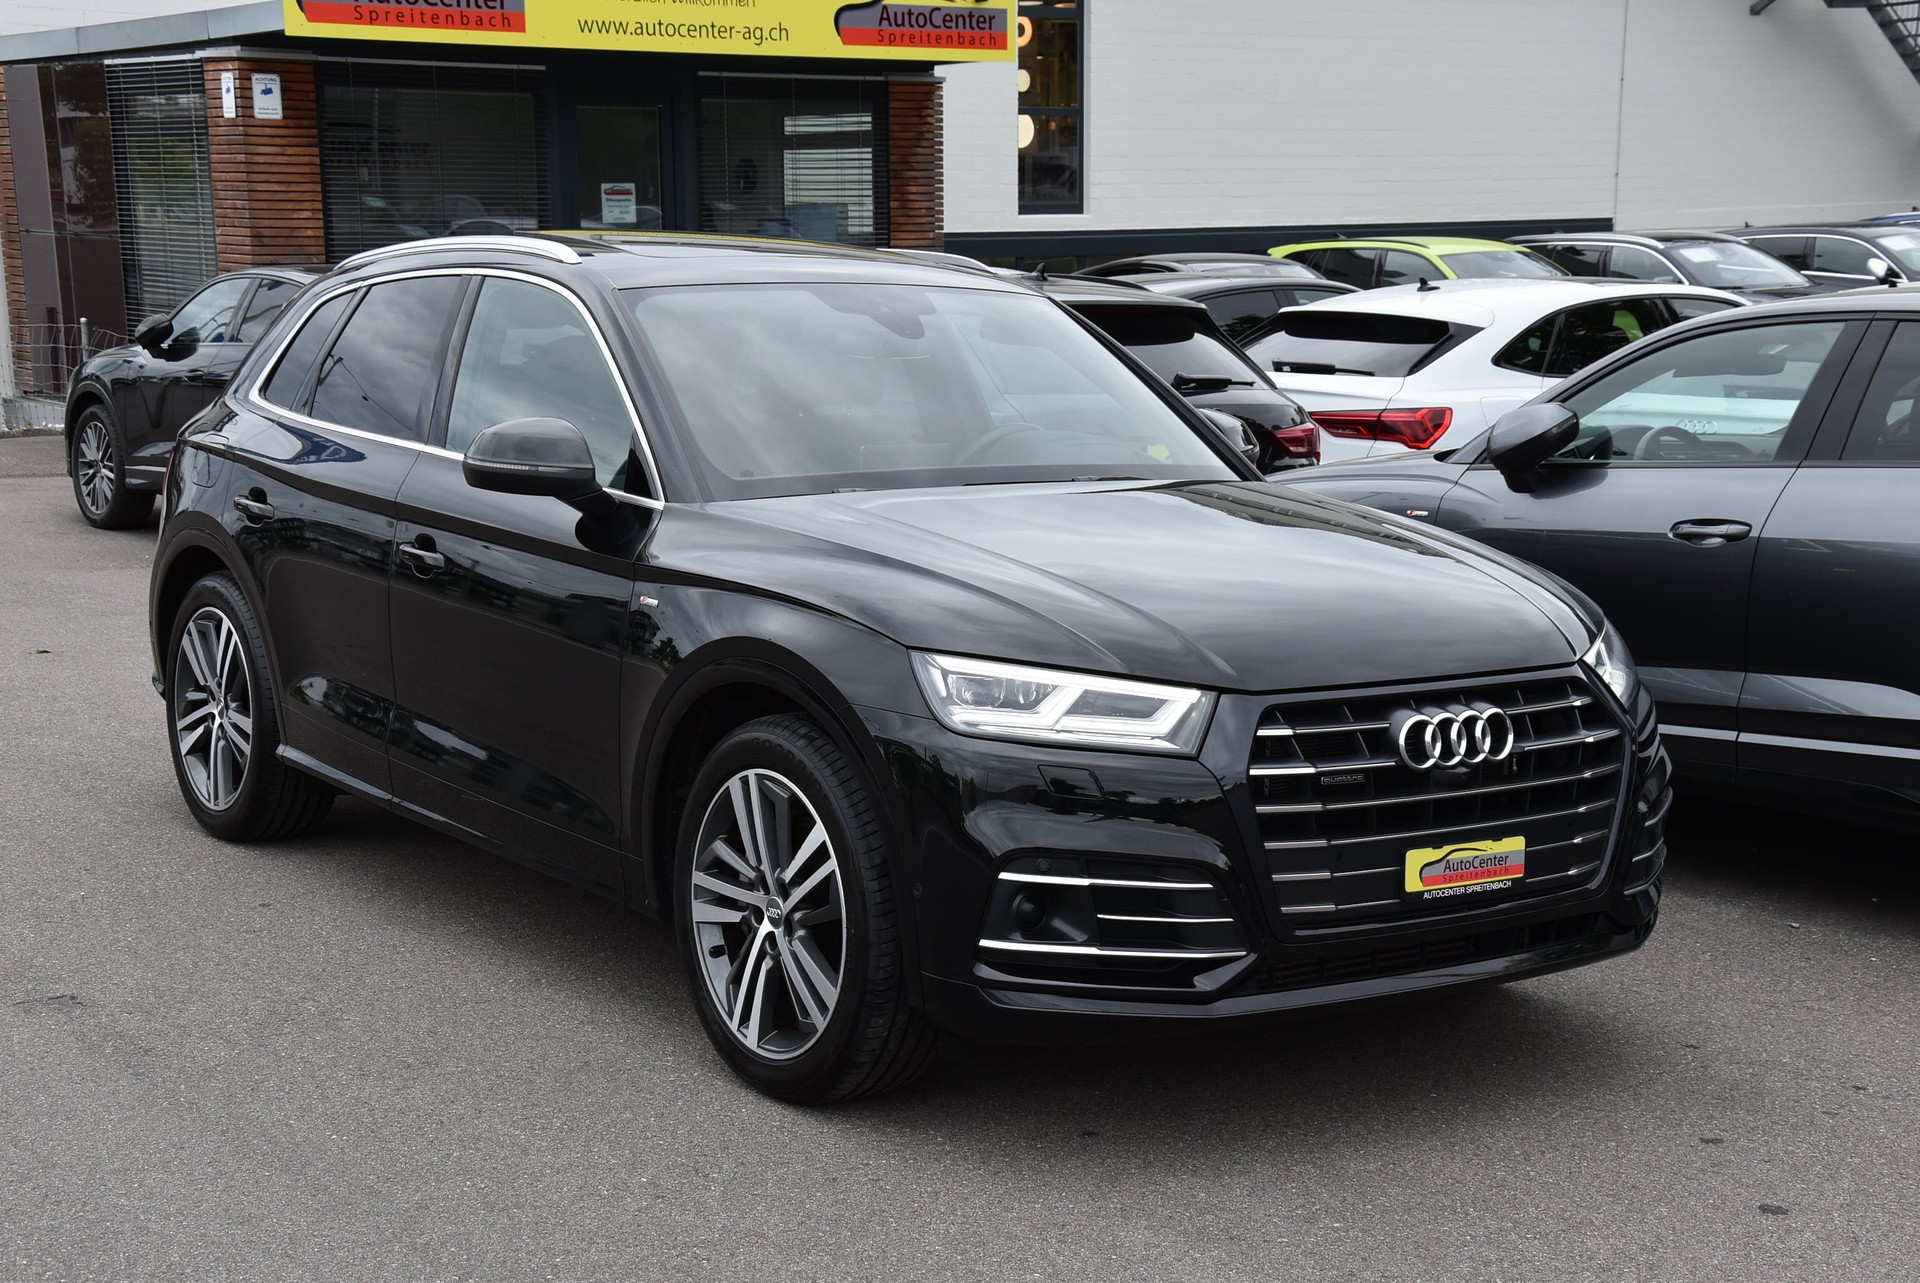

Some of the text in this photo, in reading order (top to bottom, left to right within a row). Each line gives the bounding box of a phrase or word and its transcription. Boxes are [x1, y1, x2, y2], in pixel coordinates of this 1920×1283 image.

[354, 5, 511, 28] Spreitenbach
[878, 5, 996, 31] AutoCenter
[577, 19, 790, 46] www.autocenter-ag.ch
[878, 29, 997, 46] Spreitenbach
[1443, 854, 1509, 874] AutoCenter
[1442, 866, 1509, 883] Spreitenbach
[1423, 880, 1512, 899] AUTOCENTER SPREITENBACH
